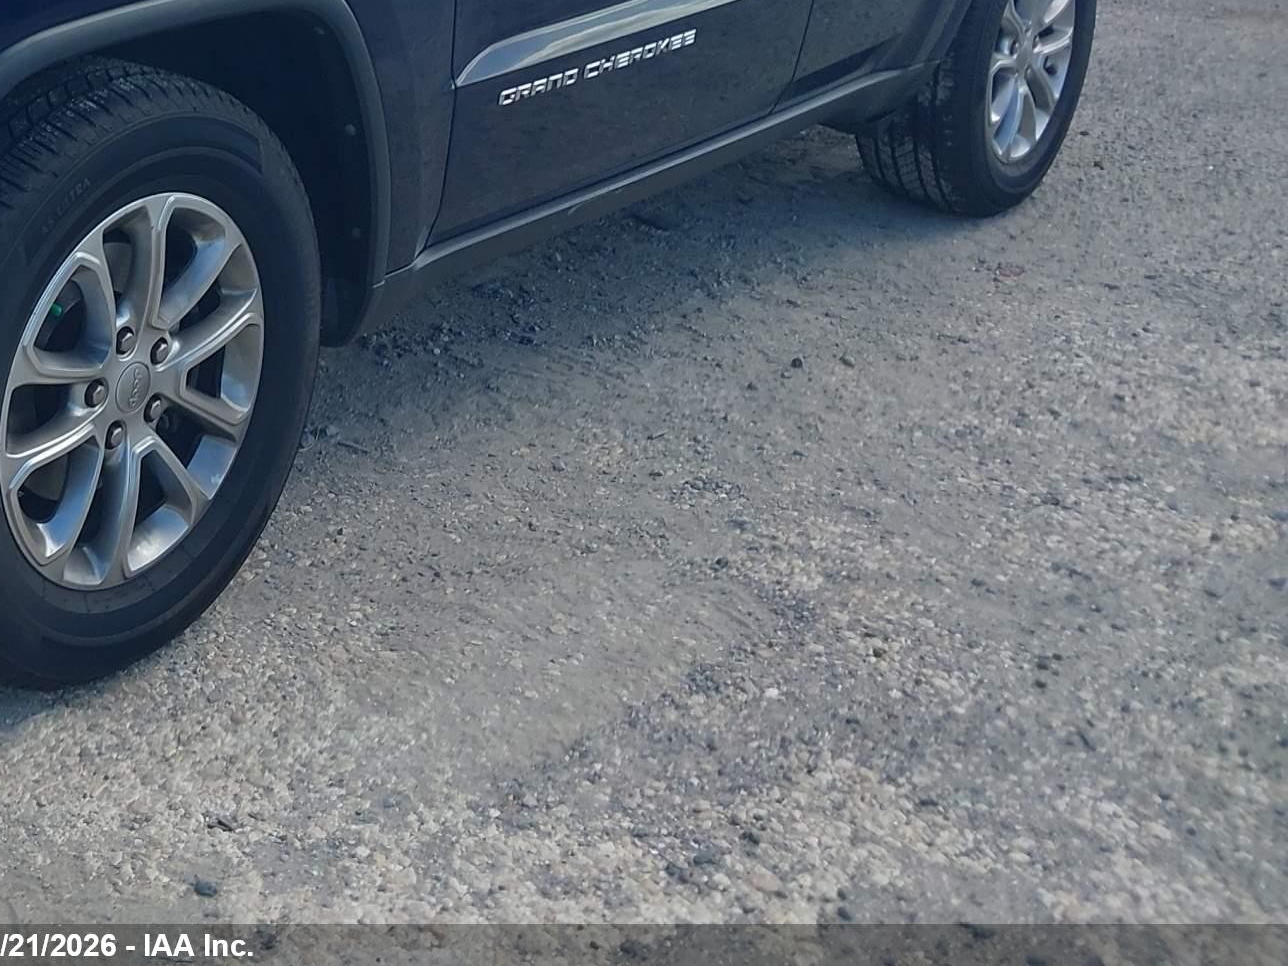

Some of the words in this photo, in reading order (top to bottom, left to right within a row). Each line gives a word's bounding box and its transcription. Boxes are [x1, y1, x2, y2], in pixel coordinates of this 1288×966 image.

[498, 67, 579, 106] GRAND
[583, 29, 697, 79] CHEROKEE
[127, 366, 144, 411] Jeep
